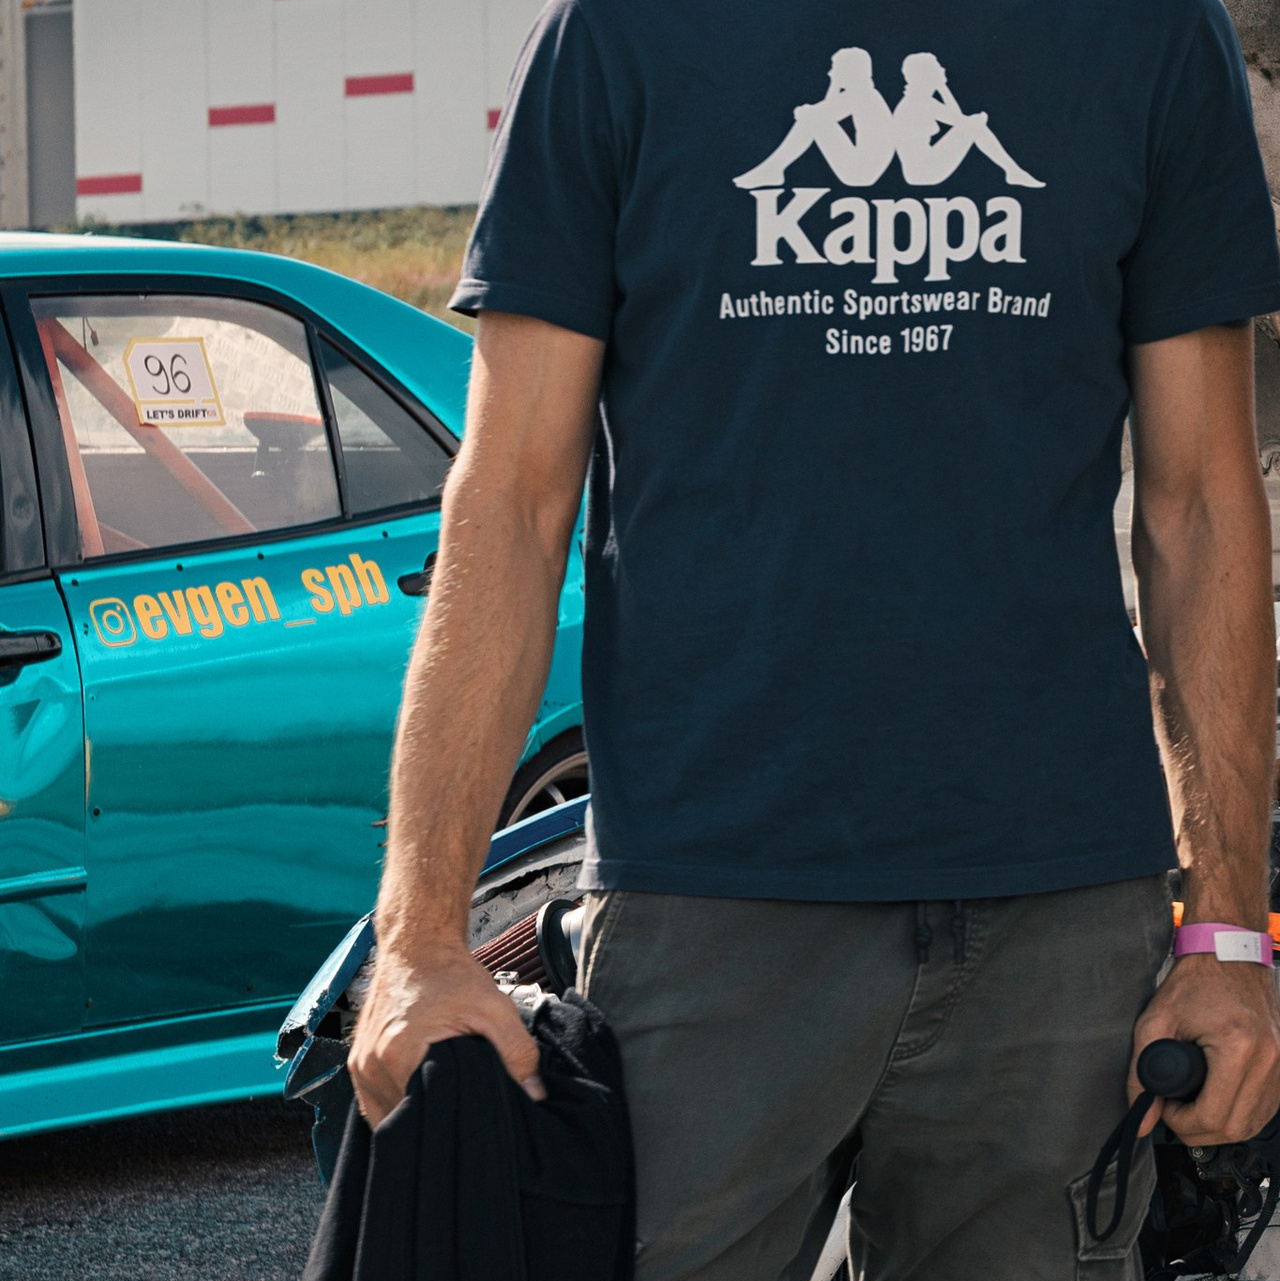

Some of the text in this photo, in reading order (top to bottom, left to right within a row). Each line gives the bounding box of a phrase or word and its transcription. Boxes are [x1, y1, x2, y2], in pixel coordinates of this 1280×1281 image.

[749, 187, 1027, 284] Kappa
[719, 287, 1052, 320] Authentic Sportswear Brand
[825, 324, 954, 356] Since 1967
[143, 353, 192, 396] 96
[146, 409, 175, 419] LET'S
